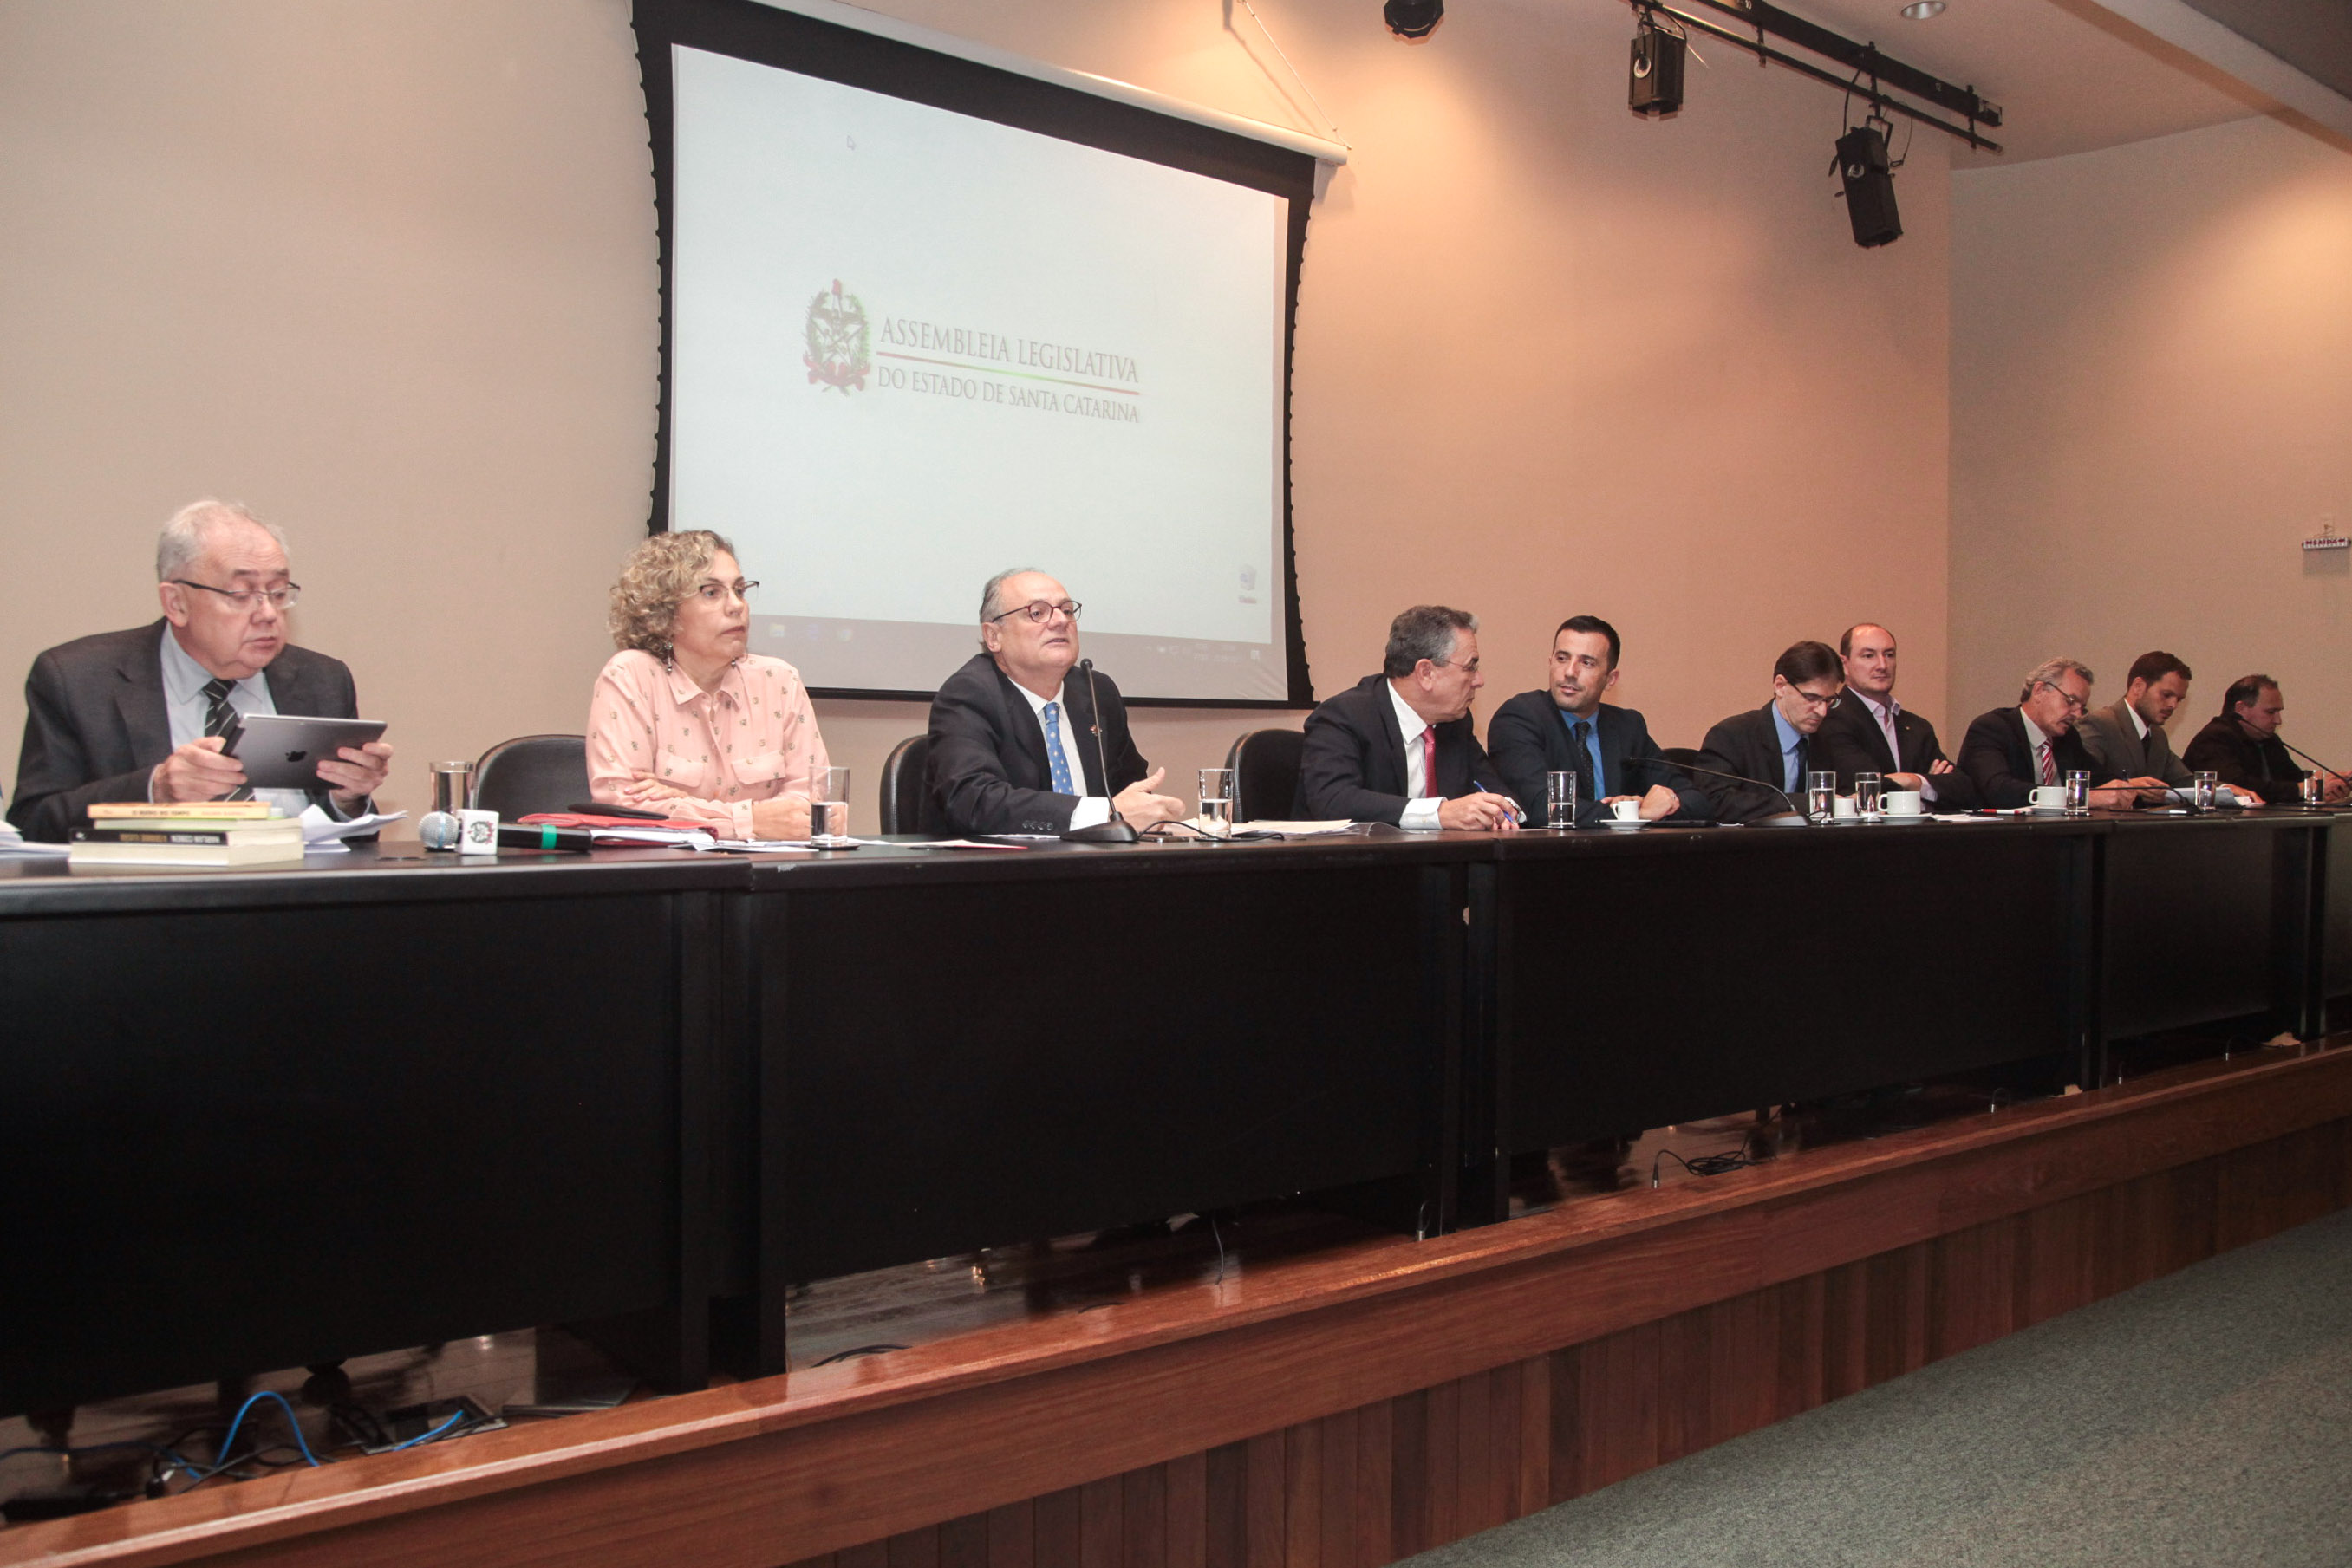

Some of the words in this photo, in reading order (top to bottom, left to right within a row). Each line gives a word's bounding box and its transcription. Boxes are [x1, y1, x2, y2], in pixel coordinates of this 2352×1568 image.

[880, 316, 1011, 362] ASSEMBLEIA
[1017, 339, 1139, 383] LEGISLATIVA
[878, 366, 905, 389] DO
[912, 371, 976, 400] ESTADO
[983, 381, 1004, 404] DE
[1009, 385, 1059, 412] SANTA
[1063, 394, 1140, 424] CATARINA
